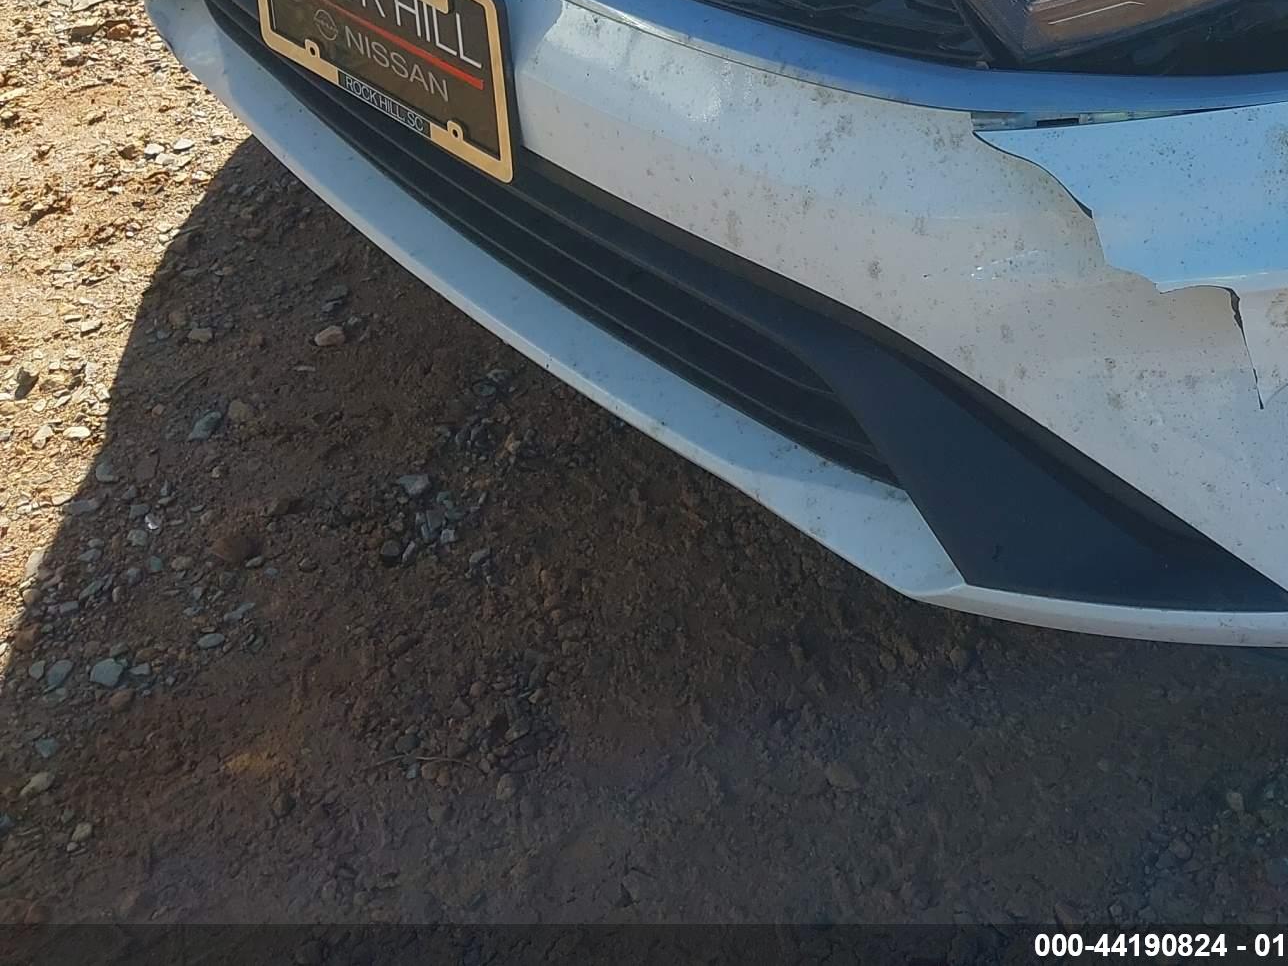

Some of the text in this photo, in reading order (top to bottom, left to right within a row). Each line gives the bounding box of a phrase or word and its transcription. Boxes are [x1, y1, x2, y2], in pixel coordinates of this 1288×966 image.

[345, 25, 448, 102] NISSAN
[345, 75, 379, 105] ROCK
[407, 111, 424, 131] SC
